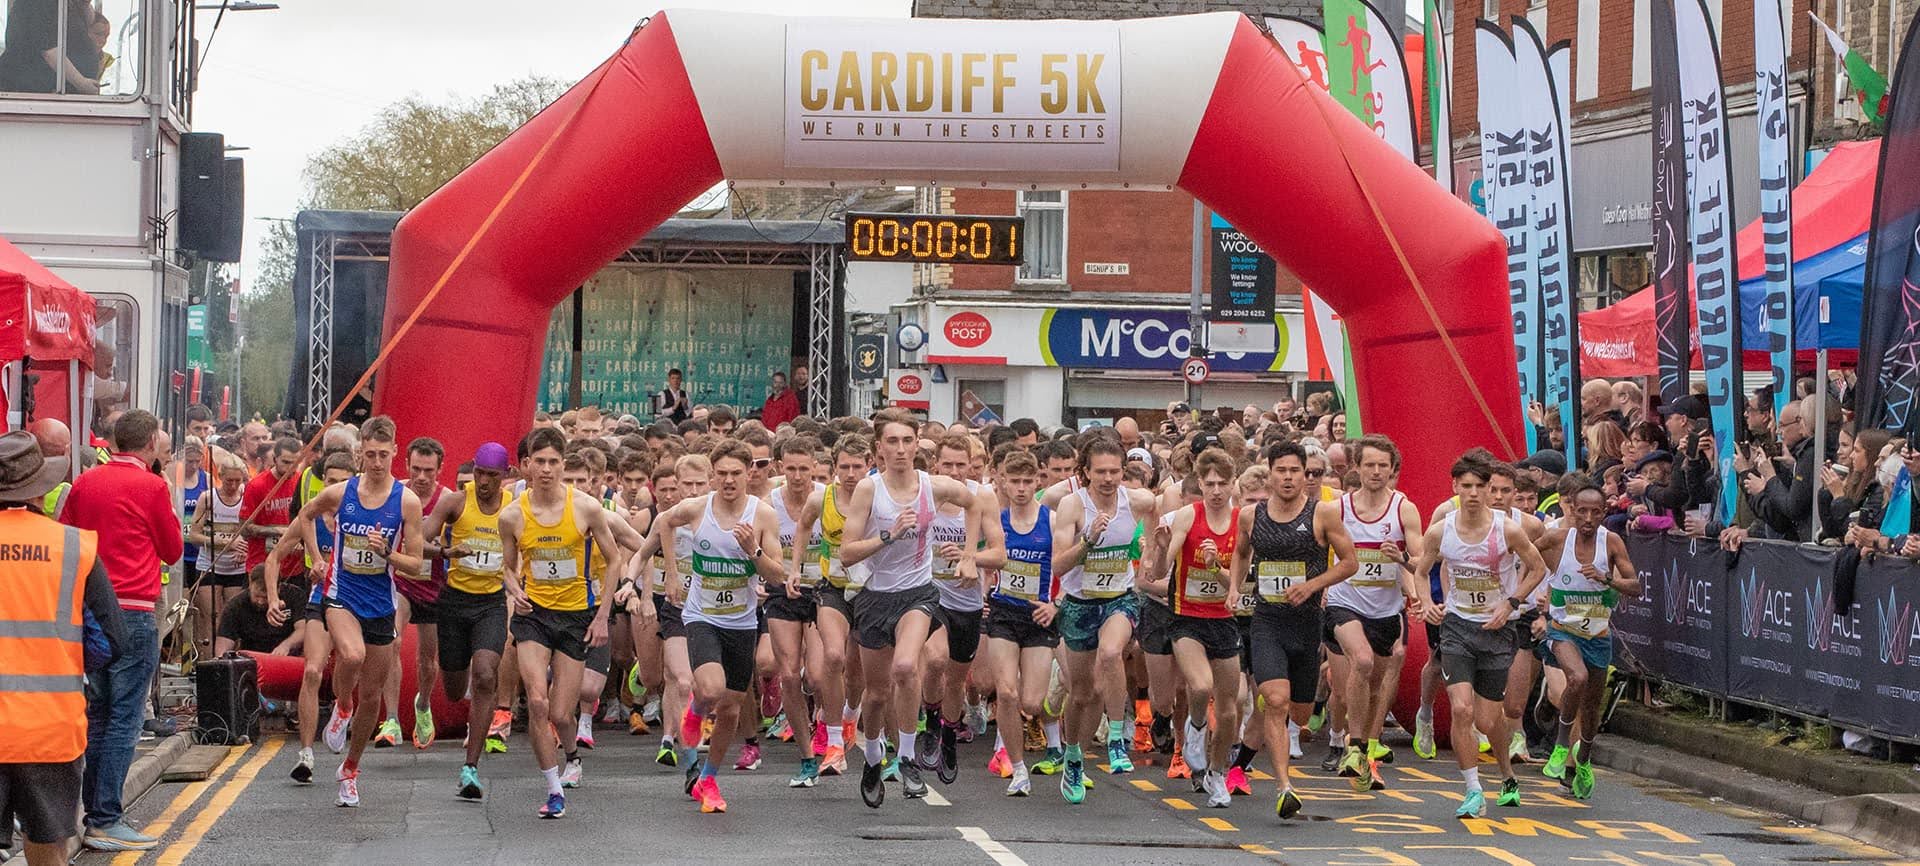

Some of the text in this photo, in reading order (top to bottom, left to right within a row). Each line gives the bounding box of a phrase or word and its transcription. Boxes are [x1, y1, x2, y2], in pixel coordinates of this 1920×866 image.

[800, 50, 1107, 115] CARDIFF 5K
[803, 121, 1105, 139] WE RUN THE STREETS
[853, 218, 1016, 259] 00:00:01
[952, 328, 985, 340] POST
[581, 340, 617, 351] RDIFF
[605, 361, 657, 373] CARDIFF
[1187, 366, 1206, 377] 20
[581, 381, 617, 392] RDIFF
[932, 526, 966, 535] WANSE
[355, 550, 374, 565] 18
[475, 550, 490, 565] 11
[1006, 548, 1046, 560] ARDIFF
[548, 561, 557, 576] 3
[702, 559, 747, 575] MIDLANDS
[1364, 563, 1383, 576] 24
[1010, 574, 1026, 588] 23
[1096, 573, 1114, 586] 27
[1273, 577, 1290, 591] 10
[1200, 581, 1218, 594] 25
[715, 590, 734, 604] 46
[1469, 592, 1486, 604] 16
[1687, 579, 1712, 615] ACE
[1763, 589, 1793, 627] ACE
[1581, 618, 1590, 630] 2
